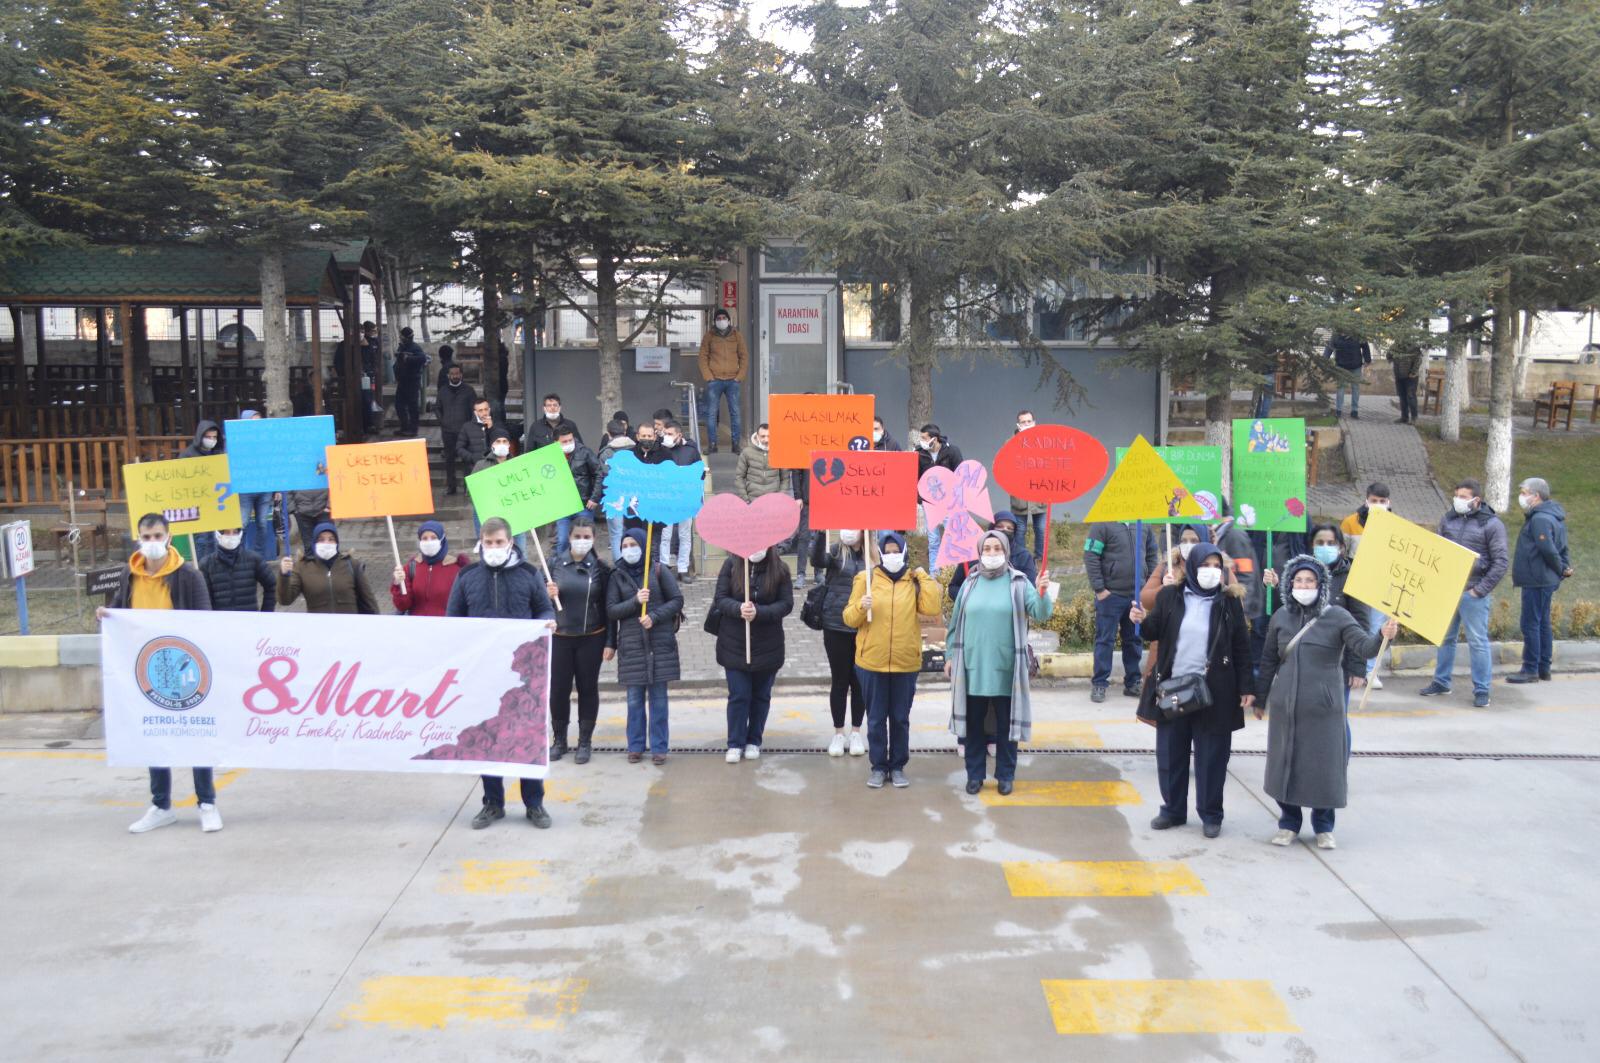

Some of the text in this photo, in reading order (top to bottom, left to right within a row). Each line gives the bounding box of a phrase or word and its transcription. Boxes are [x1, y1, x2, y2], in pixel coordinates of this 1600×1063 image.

[777, 306, 819, 320] KARANTİNA
[787, 323, 810, 334] ODASI
[144, 490, 164, 503] NE
[16, 531, 25, 546] 20
[255, 637, 301, 658] Yaşasın
[241, 655, 464, 719] 8 Mart
[143, 713, 217, 727] PETROL-İŞ GEBZE
[246, 716, 458, 746] Dünya Emekçi Kadınlar Günü
